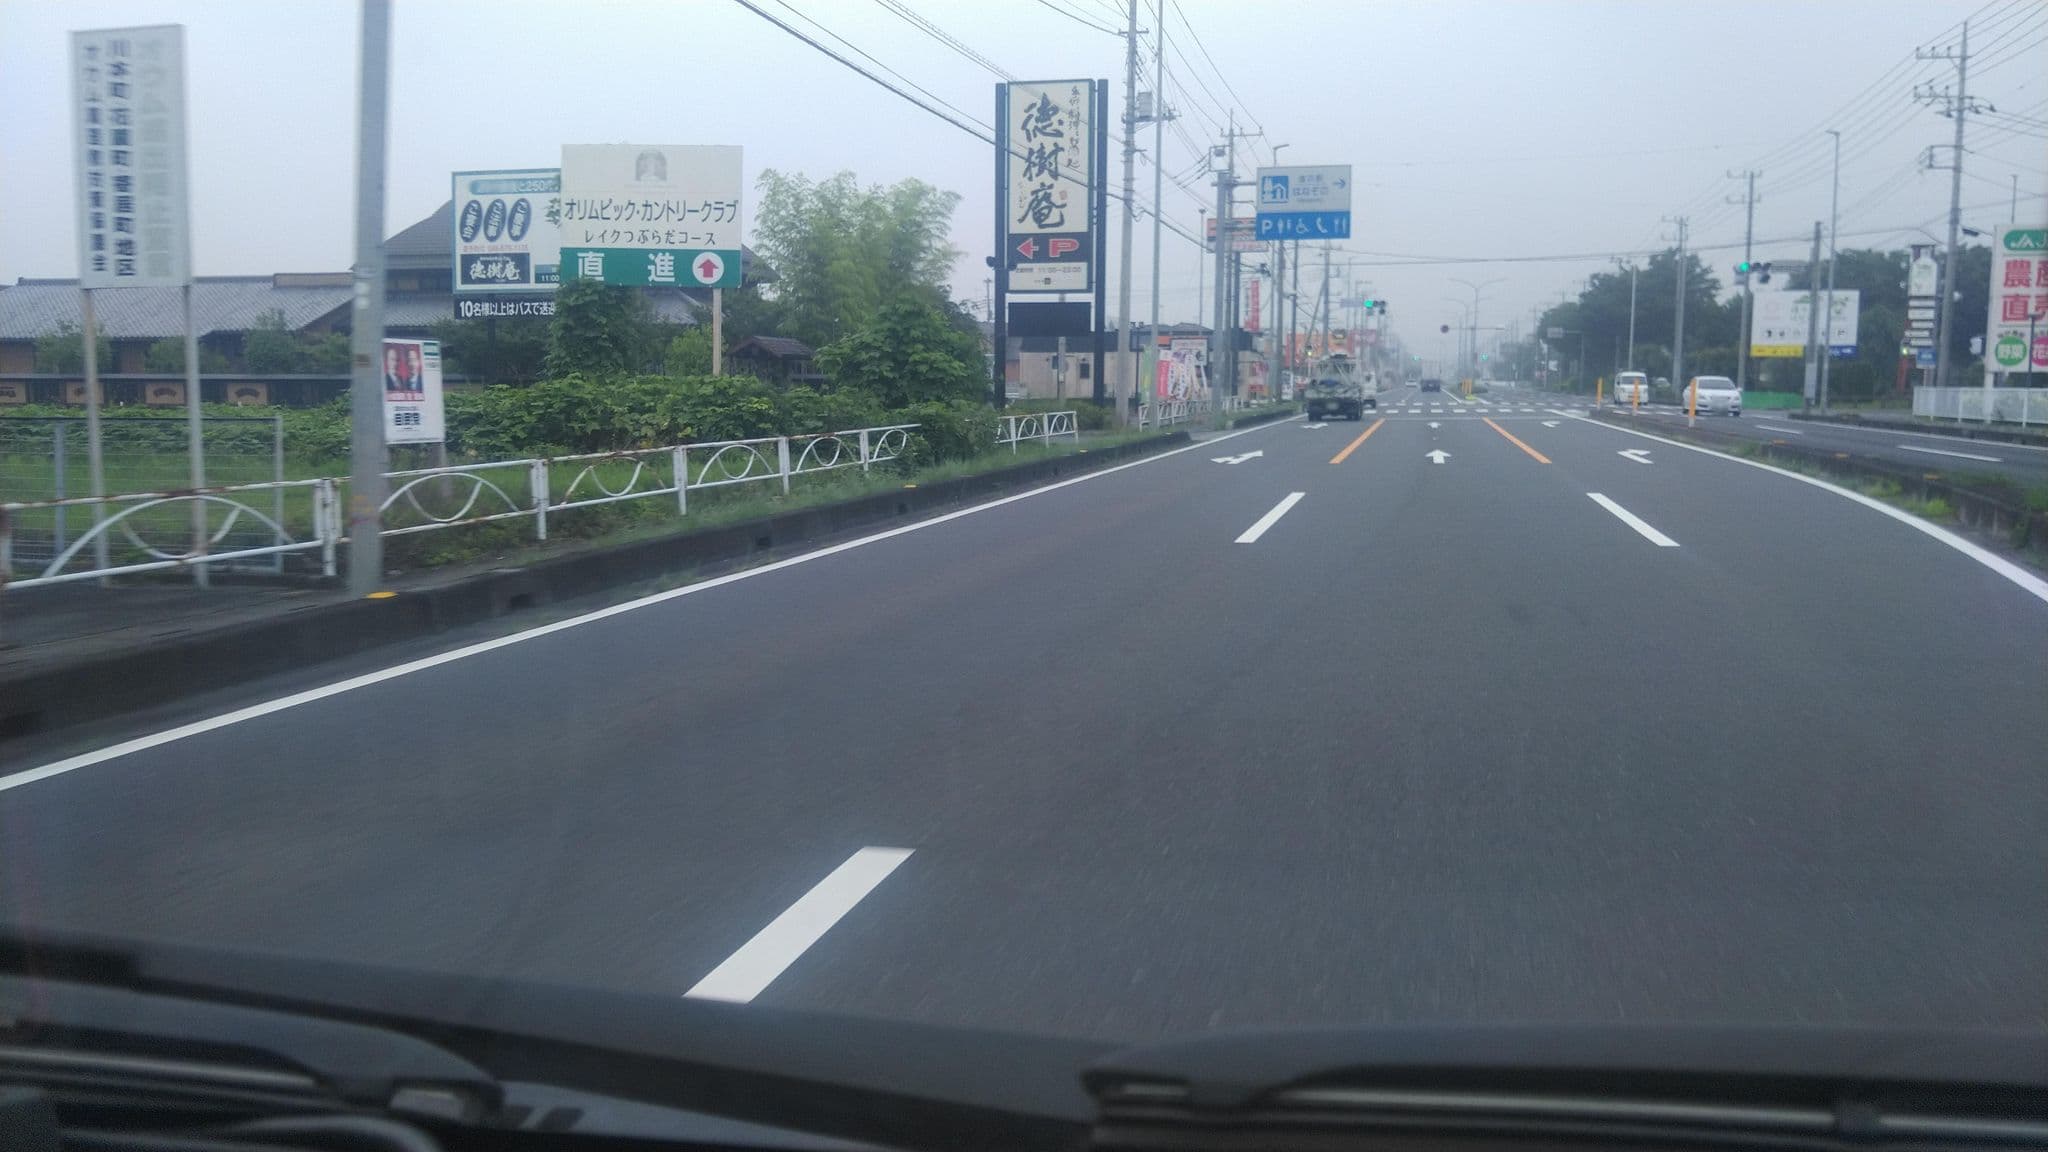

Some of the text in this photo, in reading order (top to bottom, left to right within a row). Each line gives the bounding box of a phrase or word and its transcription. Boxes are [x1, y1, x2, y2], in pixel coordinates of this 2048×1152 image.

[1017, 92, 1067, 229] 徳樹庵
[585, 229, 717, 246] レイクつぶらだコース
[1049, 238, 1080, 258] P
